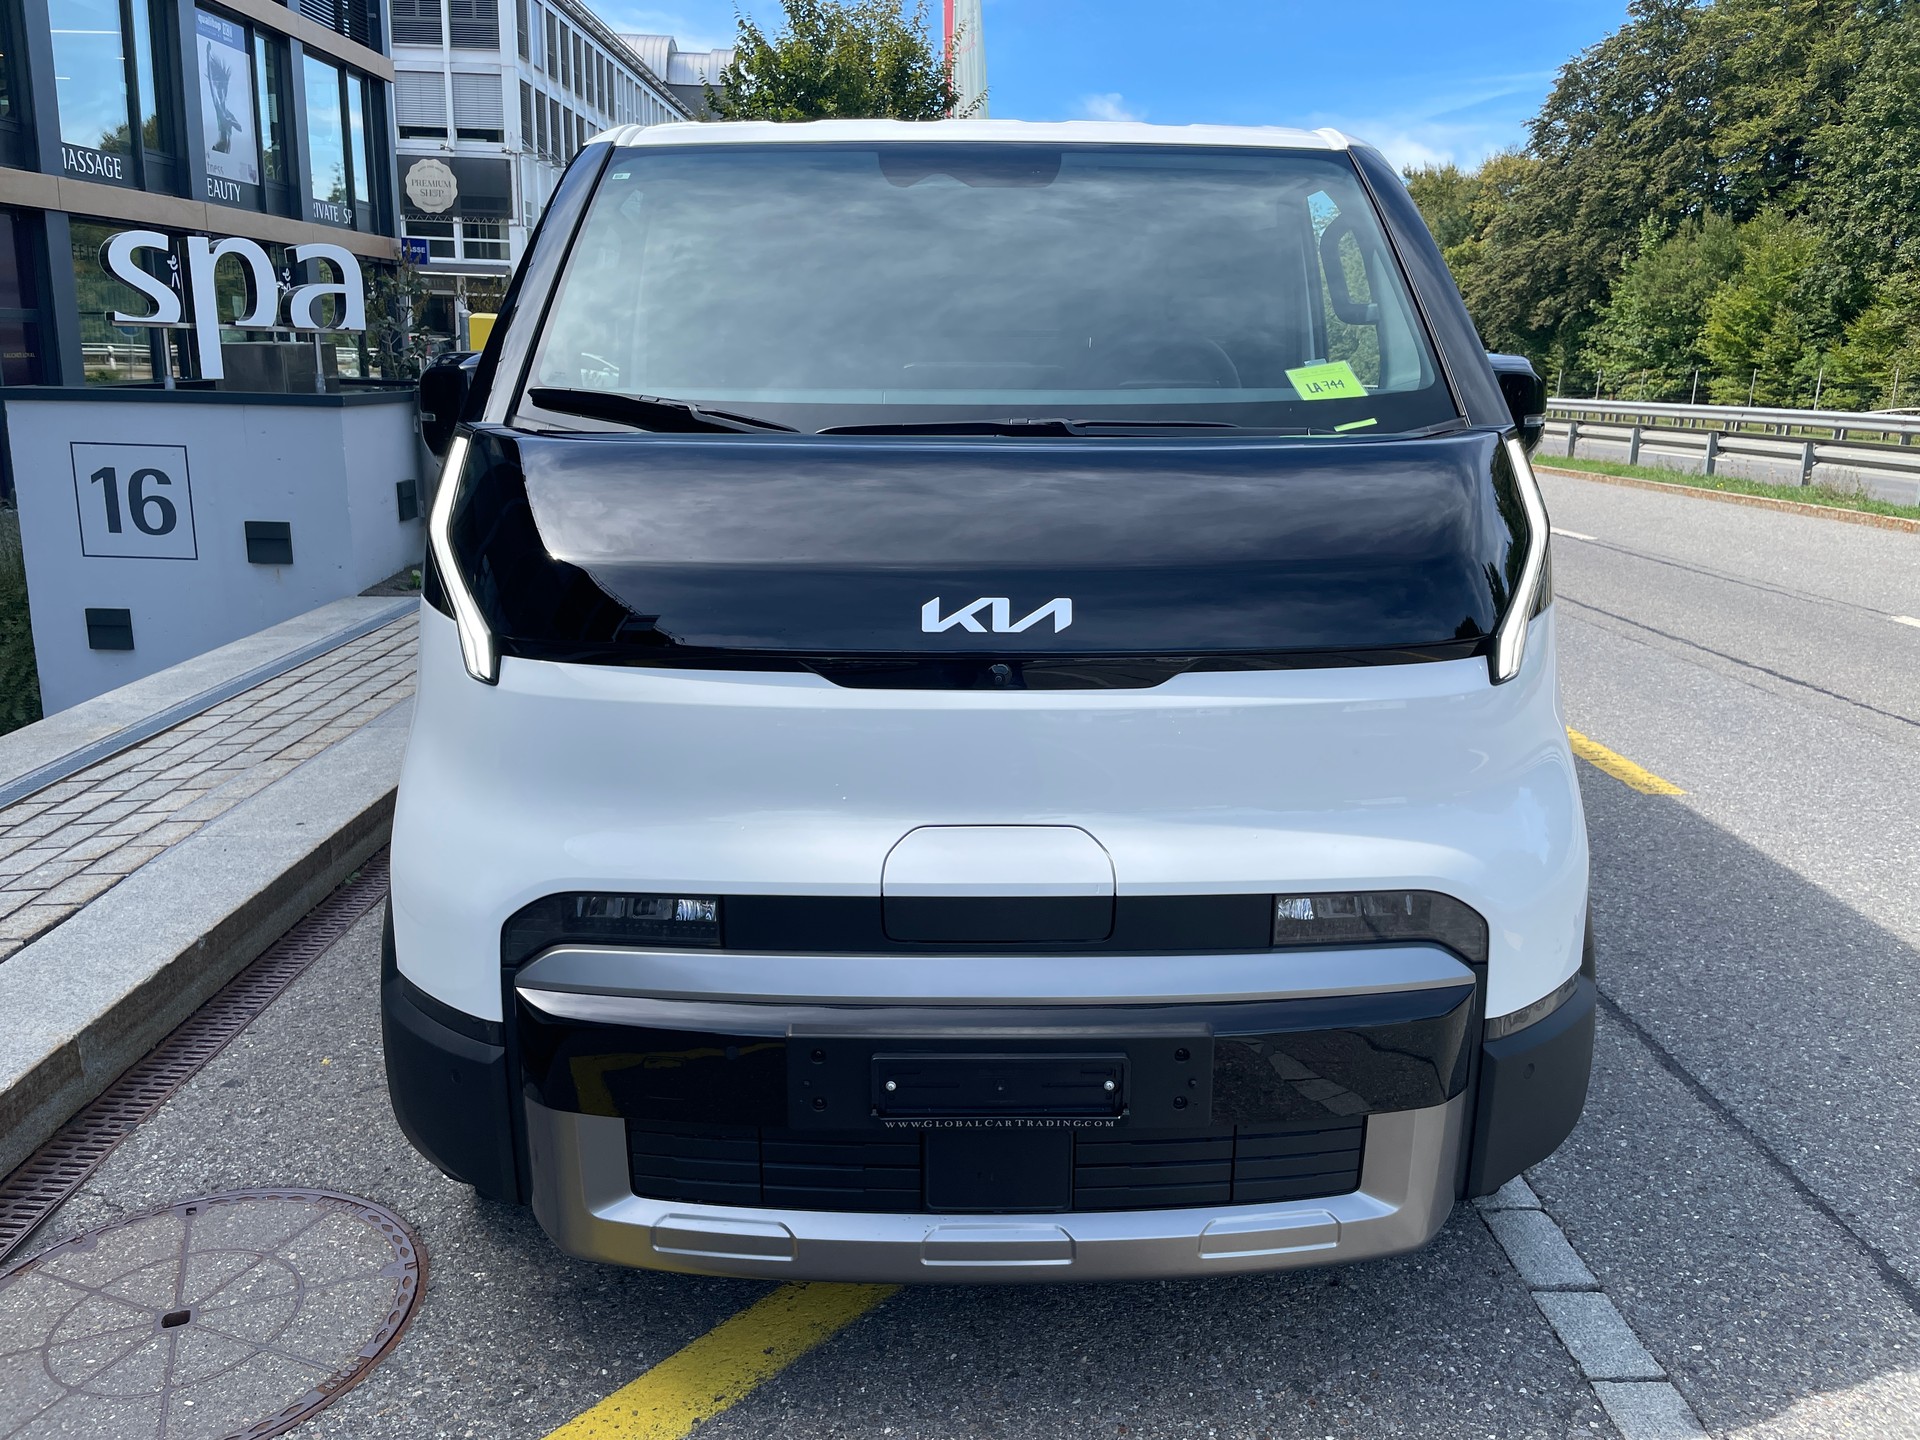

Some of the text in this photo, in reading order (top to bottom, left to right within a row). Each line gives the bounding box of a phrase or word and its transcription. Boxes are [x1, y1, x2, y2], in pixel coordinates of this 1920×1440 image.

[411, 179, 452, 188] PREMIUM
[420, 188, 445, 197] SHOP
[99, 230, 366, 380] spa
[1306, 379, 1345, 394] LA 744
[90, 466, 177, 536] 16
